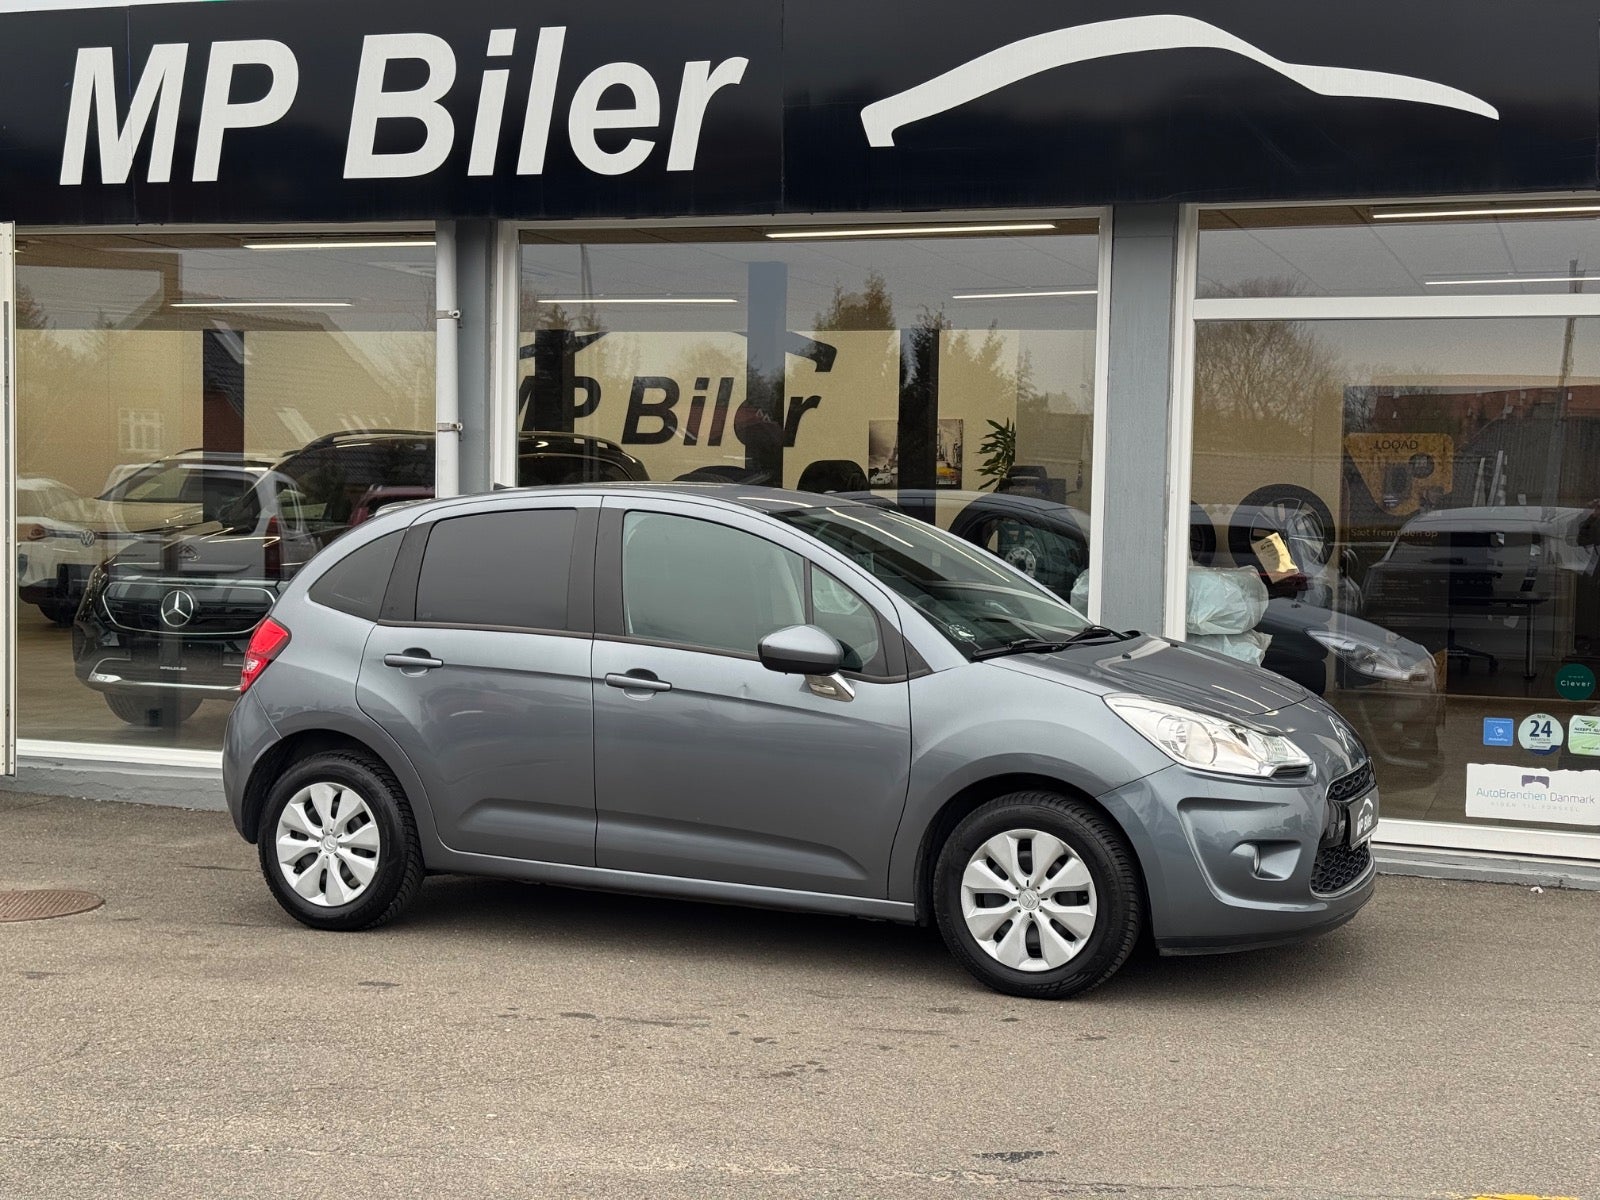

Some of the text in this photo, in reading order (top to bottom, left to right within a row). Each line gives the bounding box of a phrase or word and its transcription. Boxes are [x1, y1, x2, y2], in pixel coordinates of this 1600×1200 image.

[59, 26, 749, 186] MP Biler
[621, 375, 821, 447] Bilr
[1560, 679, 1591, 688] Clever
[1529, 719, 1552, 737] 24
[1476, 787, 1595, 805] AutoBranchen Danmark
